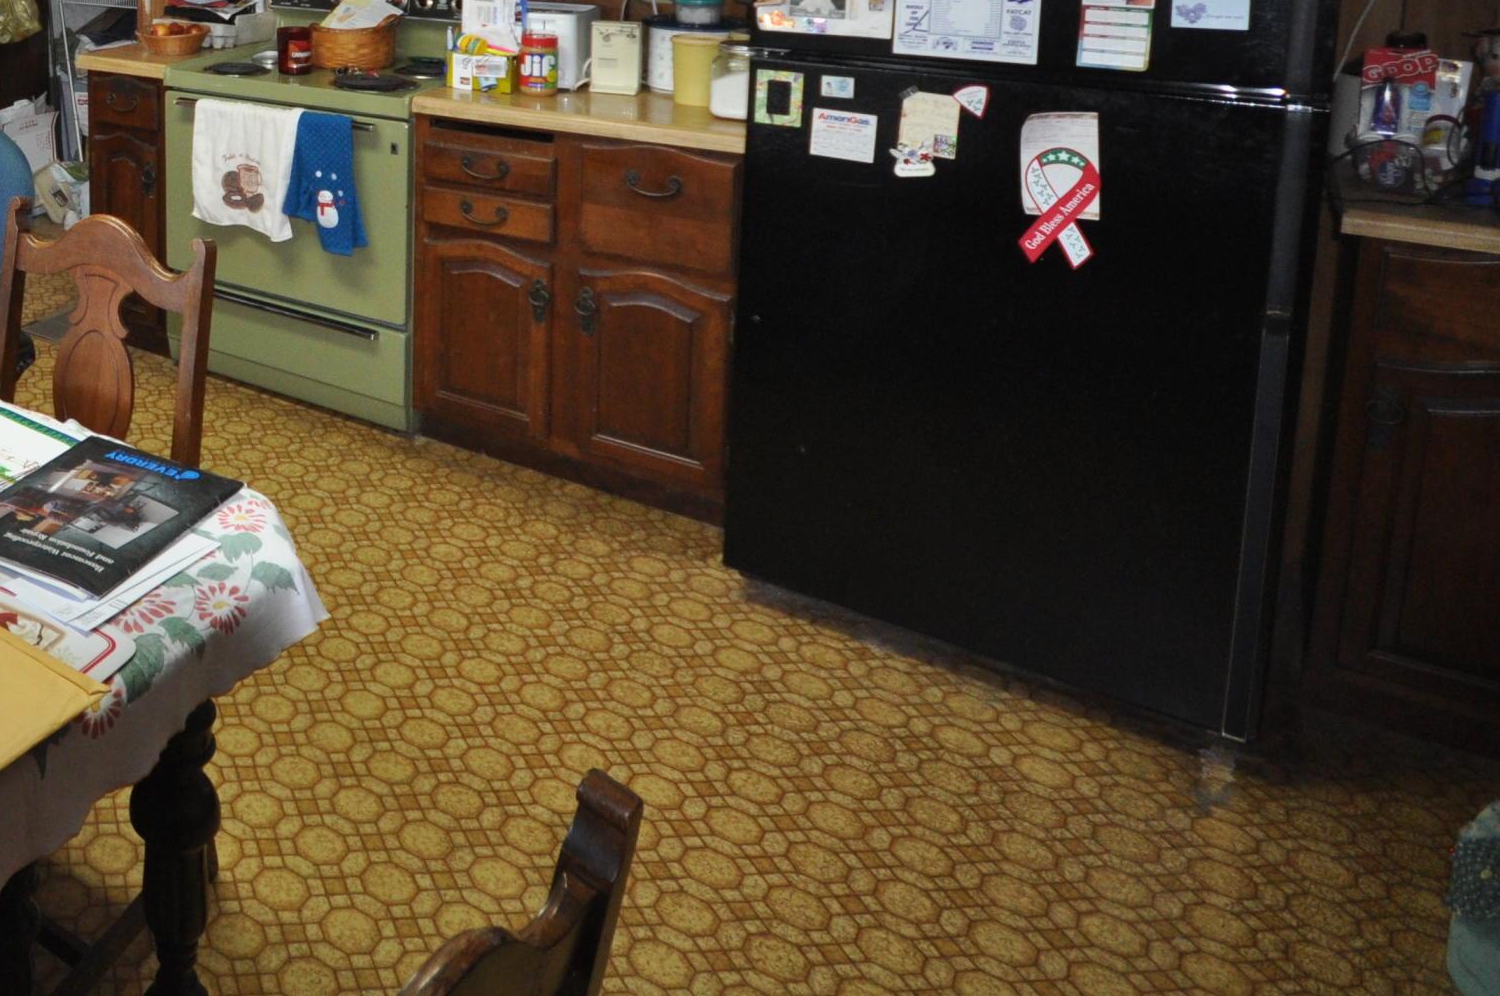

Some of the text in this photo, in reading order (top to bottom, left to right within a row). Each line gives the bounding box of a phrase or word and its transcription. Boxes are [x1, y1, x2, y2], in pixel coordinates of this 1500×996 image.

[819, 112, 871, 126] AmeriGas
[1024, 183, 1095, 250] God Bless America
[104, 450, 180, 477] EVERDRY
[48, 536, 96, 560] Foundation
[97, 554, 115, 565] and
